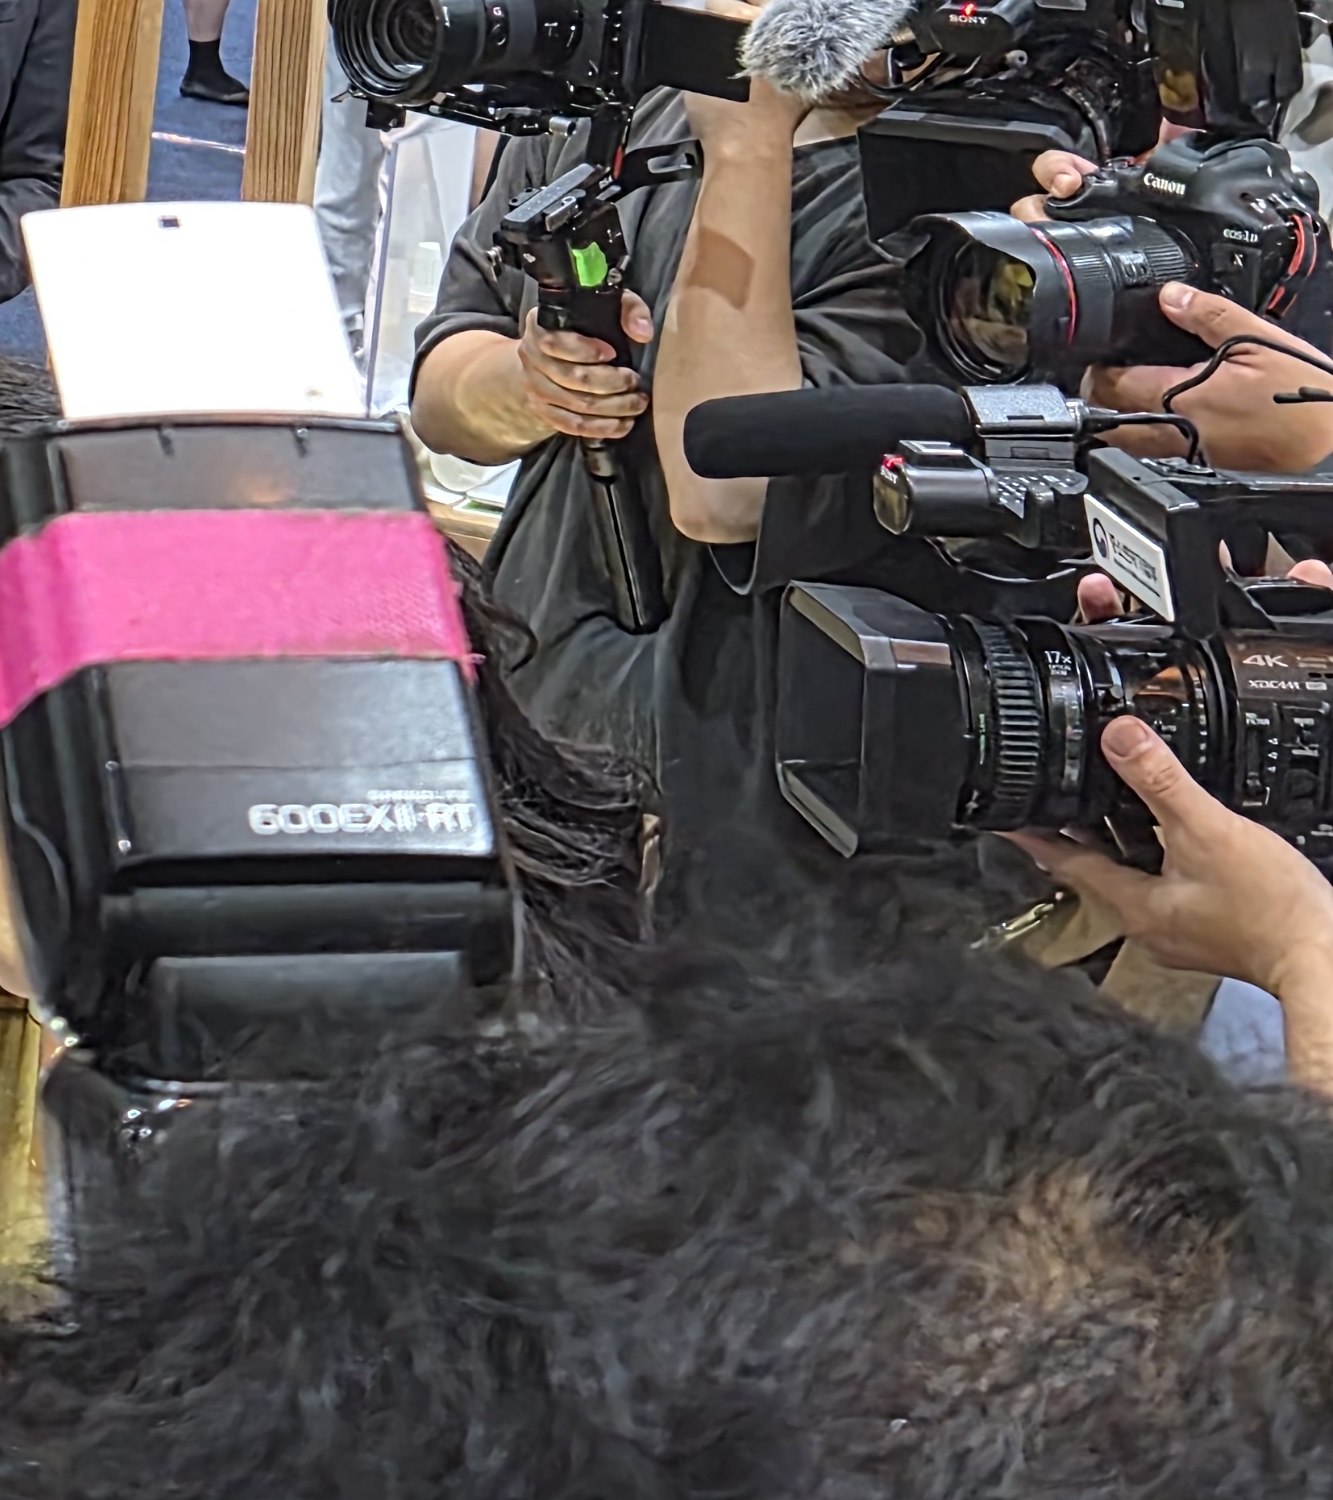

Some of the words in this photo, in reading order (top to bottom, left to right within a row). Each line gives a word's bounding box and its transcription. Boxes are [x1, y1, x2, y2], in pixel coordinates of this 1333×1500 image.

[949, 14, 988, 25] SONY
[1143, 172, 1186, 195] Canon
[1242, 654, 1289, 668] 4K
